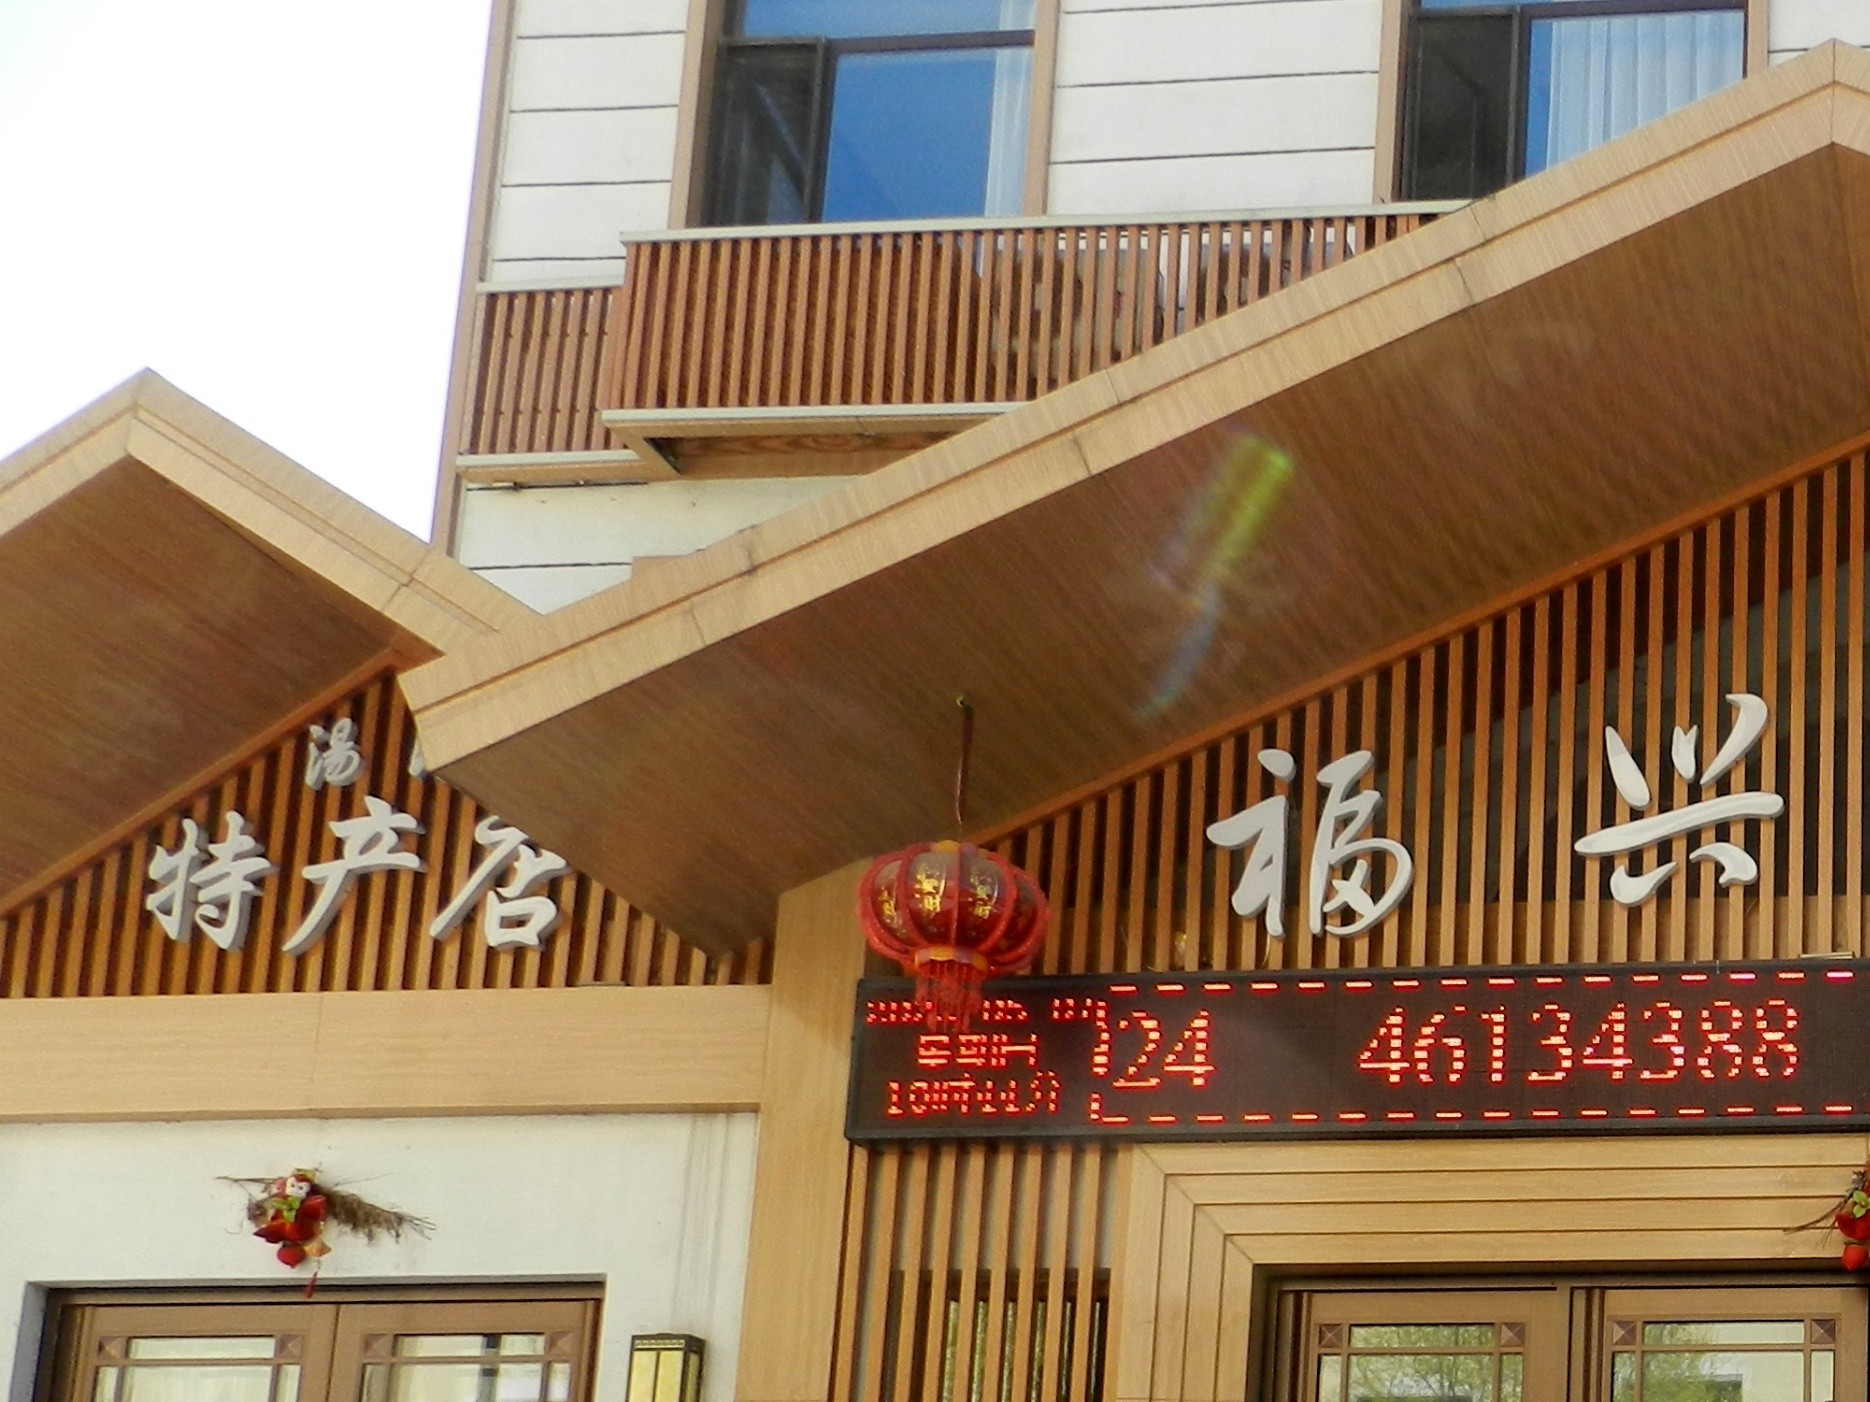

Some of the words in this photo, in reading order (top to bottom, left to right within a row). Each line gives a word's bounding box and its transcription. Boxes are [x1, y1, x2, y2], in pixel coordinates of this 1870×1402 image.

[146, 795, 572, 956] 特产店
[1359, 999, 1799, 1083] 46134388
